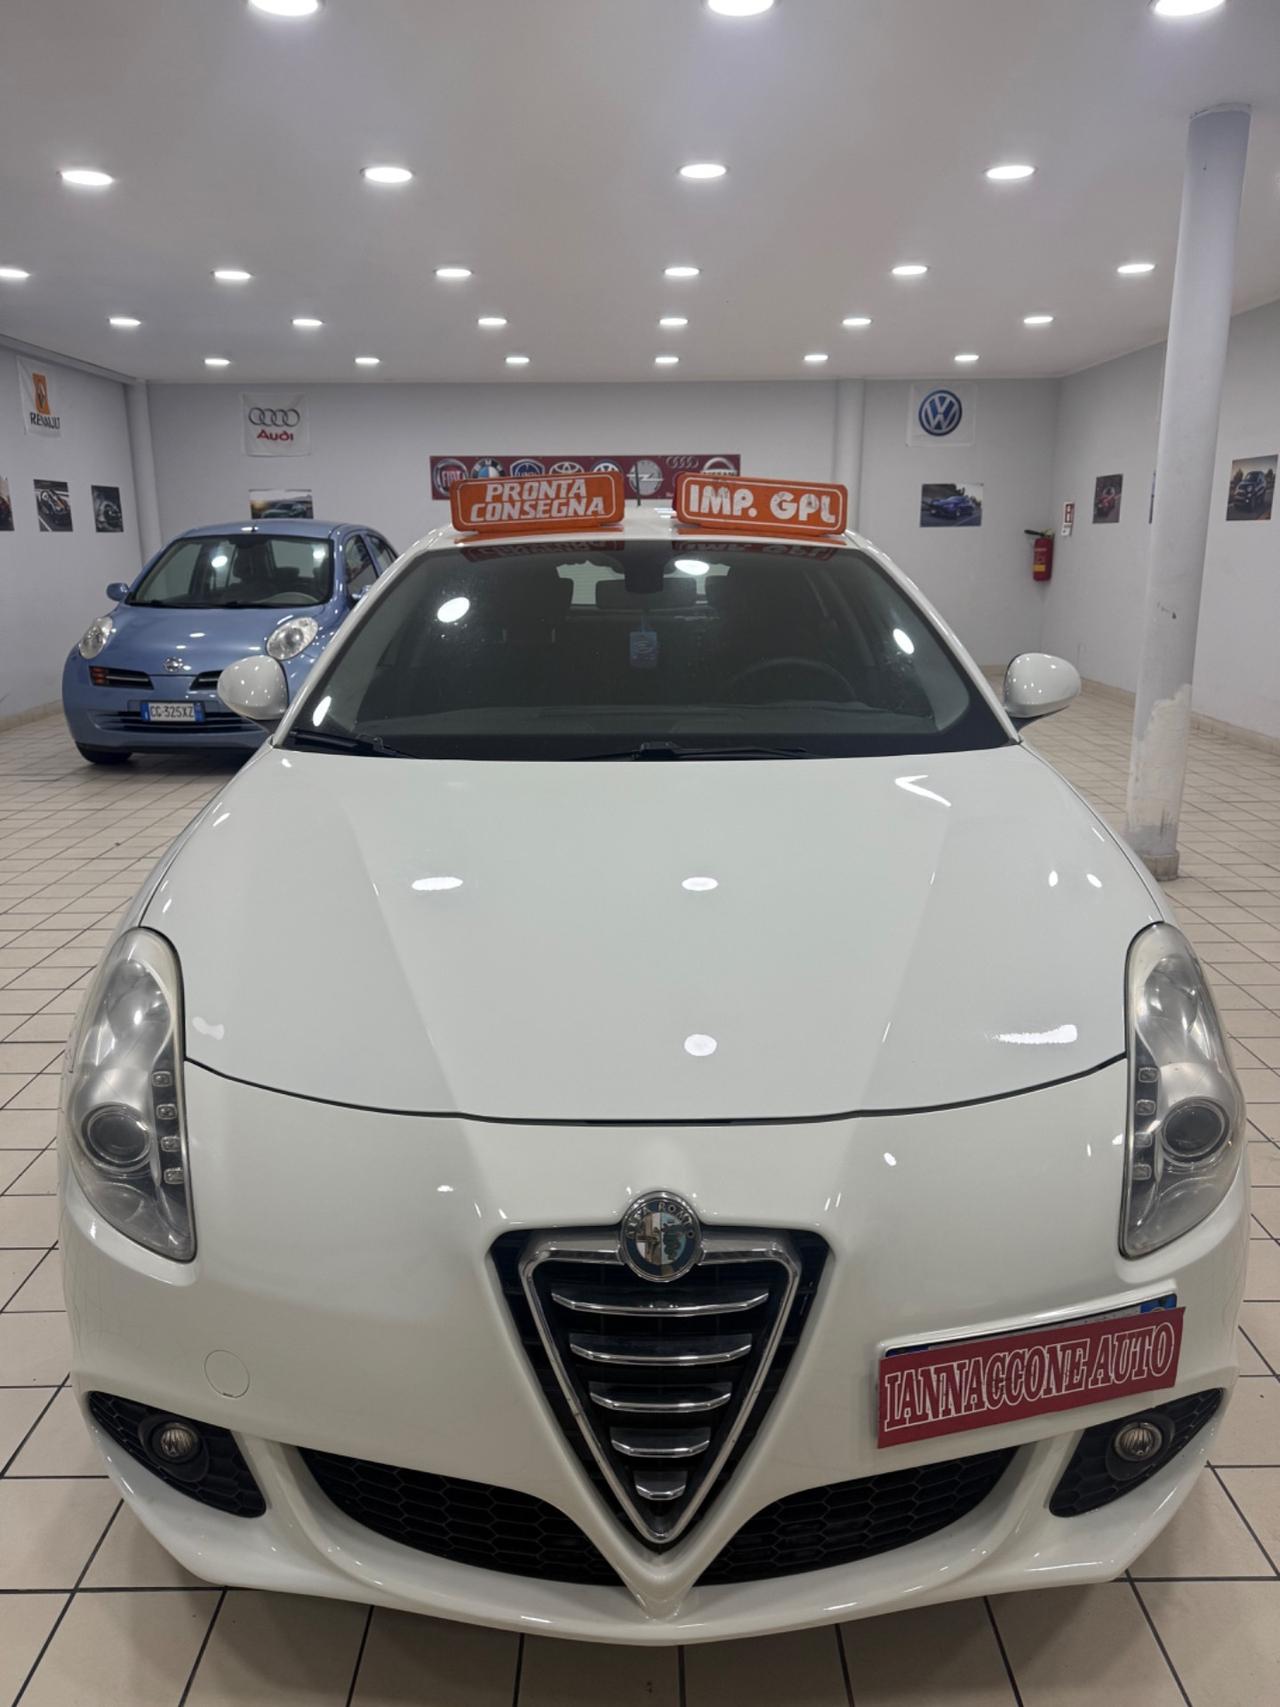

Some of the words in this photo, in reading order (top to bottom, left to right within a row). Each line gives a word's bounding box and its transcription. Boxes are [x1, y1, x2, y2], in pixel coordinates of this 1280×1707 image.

[257, 429, 294, 441] Audi
[441, 470, 462, 487] FIAT
[485, 479, 587, 502] PRONTA
[470, 496, 606, 522] CONSEGNA
[689, 484, 758, 517] IMP.
[770, 491, 836, 523] GPL
[657, 1200, 695, 1239] ROMEO
[884, 1339, 1090, 1432] IANNACCONE
[1087, 1321, 1175, 1390] AUTO
